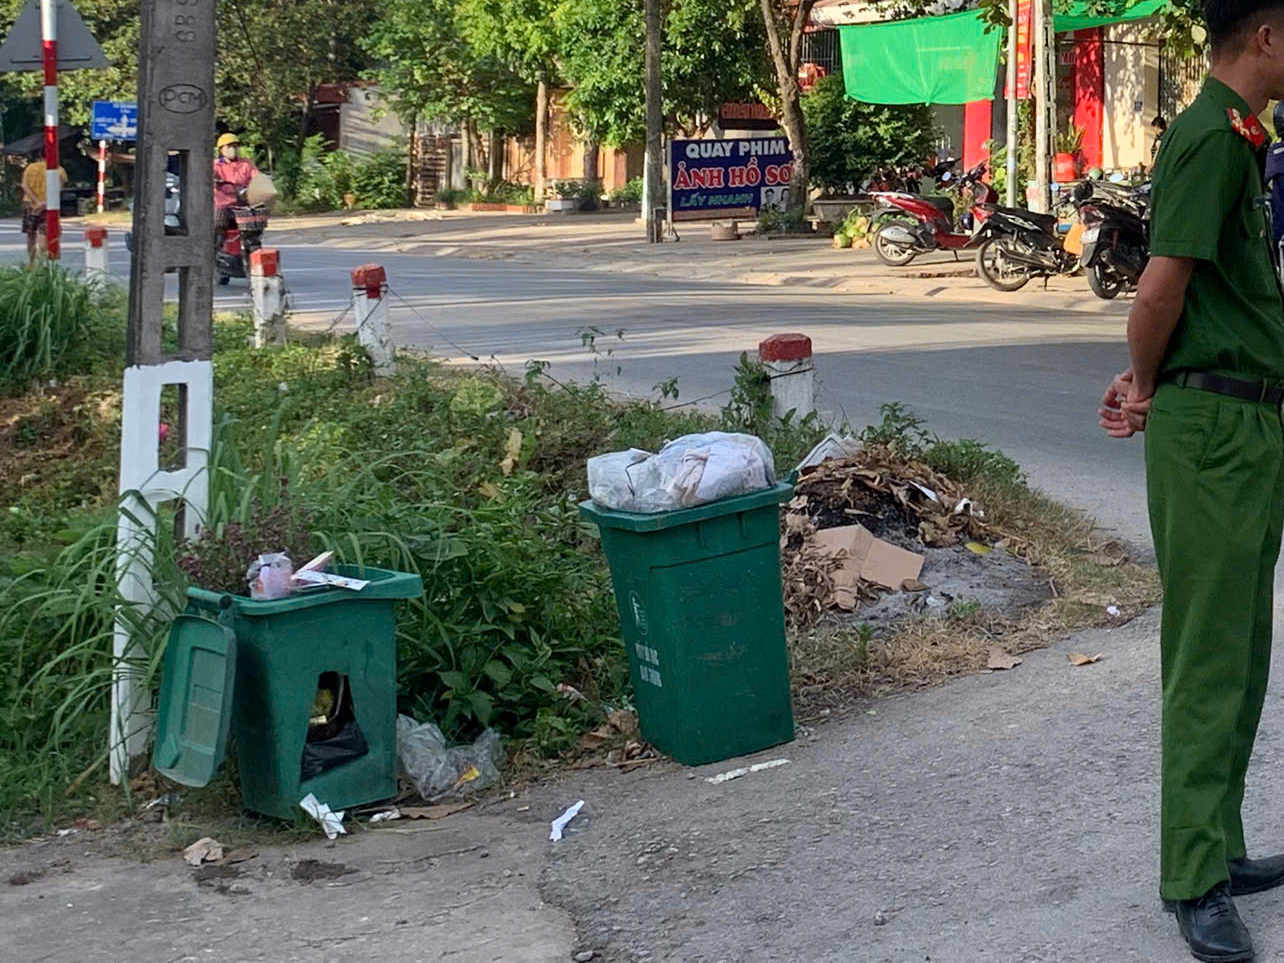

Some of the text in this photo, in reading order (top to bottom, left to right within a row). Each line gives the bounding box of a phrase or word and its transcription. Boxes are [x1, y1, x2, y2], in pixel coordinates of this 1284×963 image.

[686, 140, 786, 159] QUAY PHIM
[673, 161, 725, 190] ẢNH
[728, 156, 761, 188] HỒ
